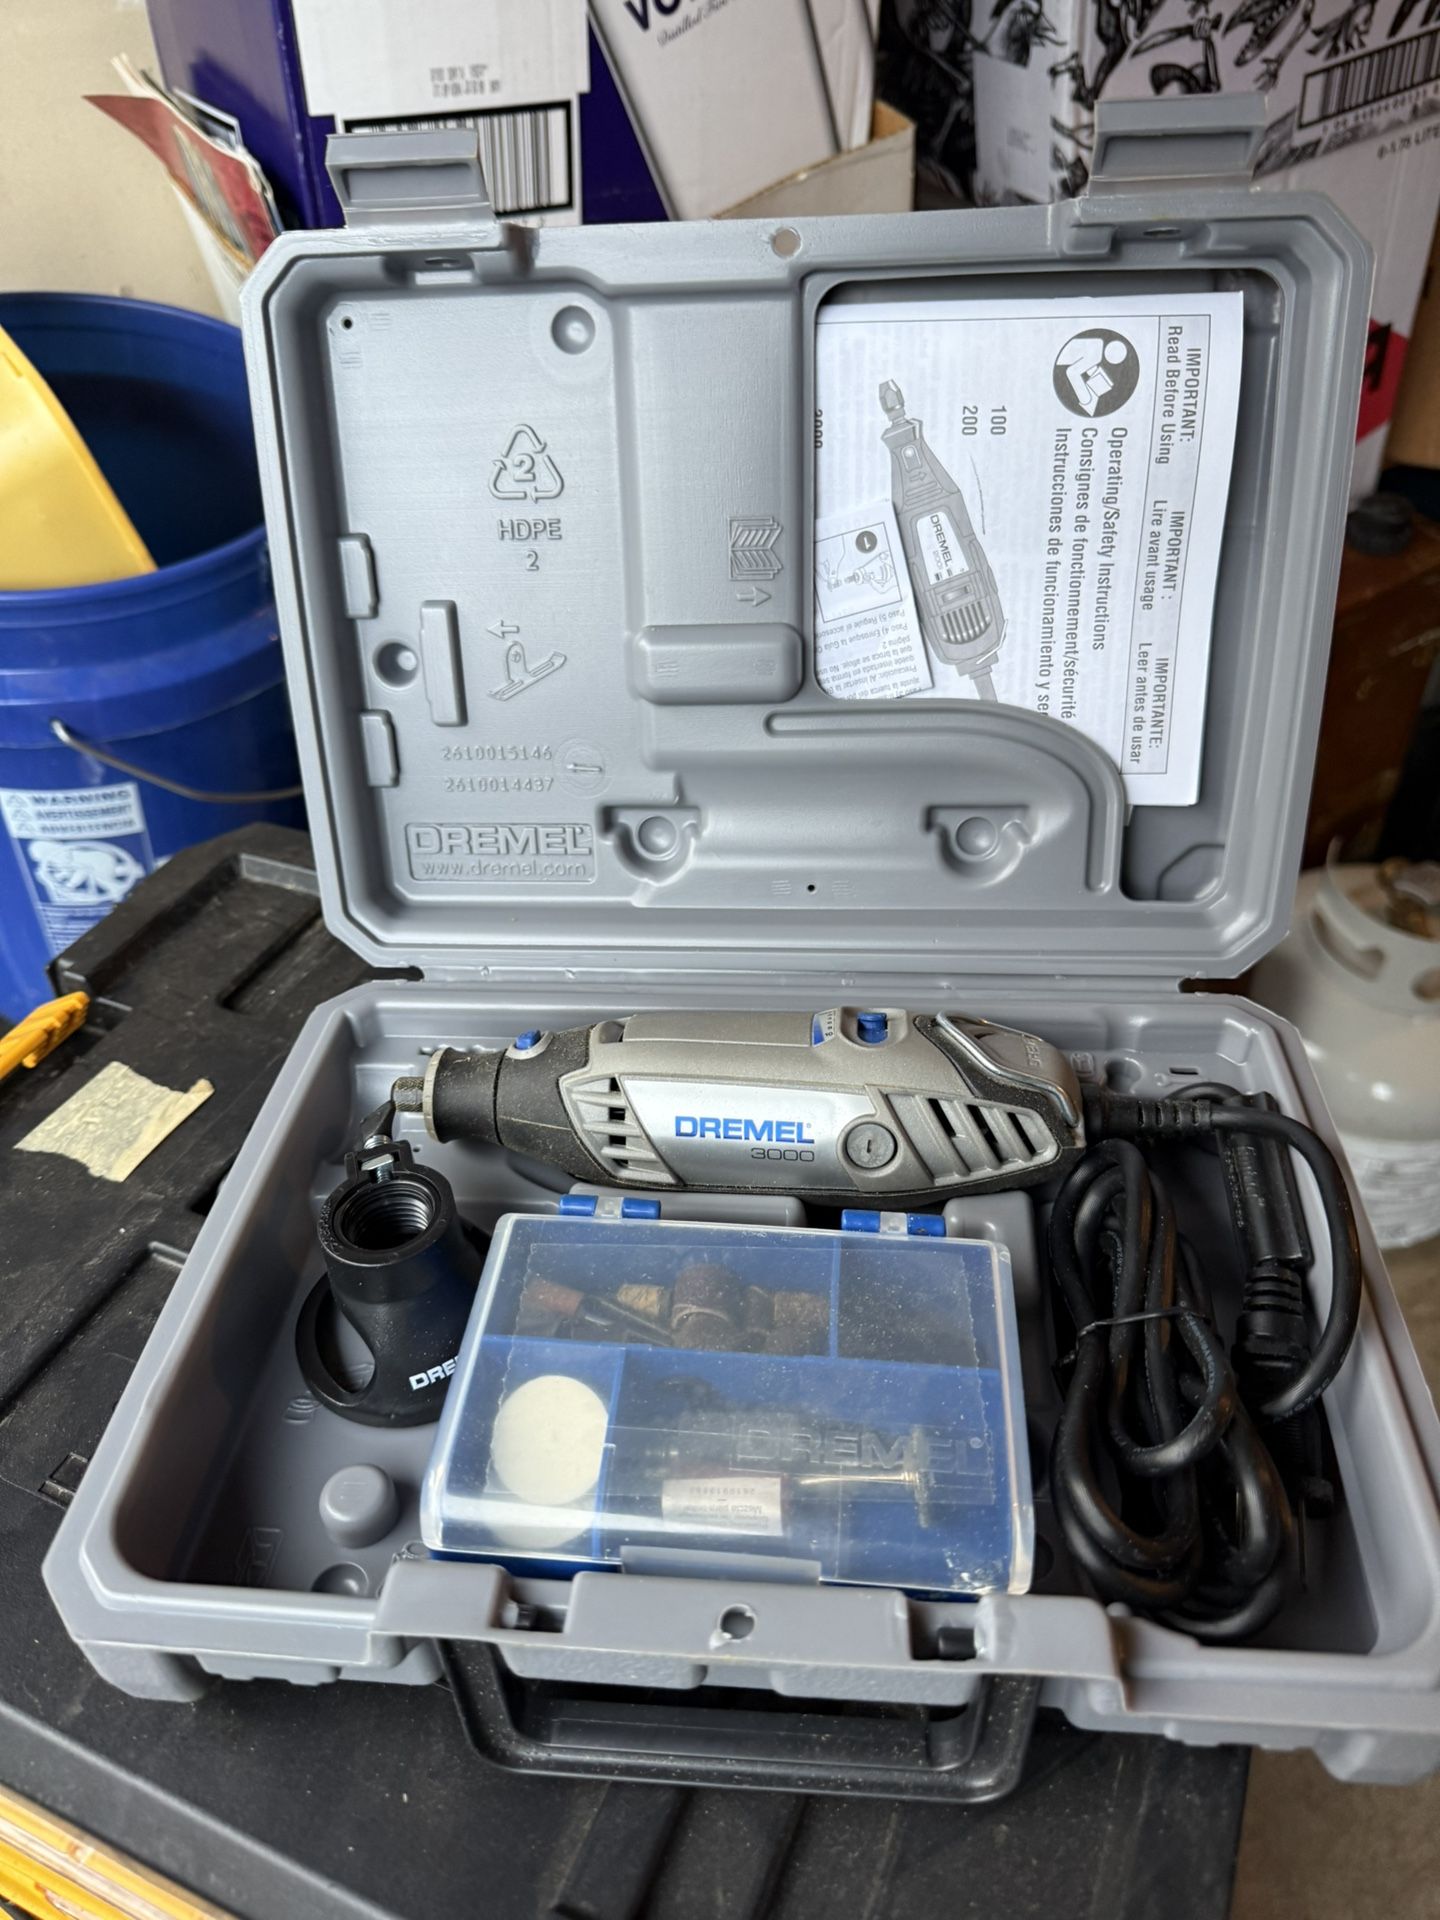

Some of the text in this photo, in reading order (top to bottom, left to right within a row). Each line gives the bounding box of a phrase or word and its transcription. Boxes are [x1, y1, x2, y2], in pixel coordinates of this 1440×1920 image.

[1155, 326, 1183, 465] Read Before Using
[1179, 348, 1202, 443] IMPORTANT:
[961, 405, 978, 436] 200
[990, 405, 1007, 436] 100
[513, 453, 537, 483] 2
[1049, 428, 1072, 533] Instrucciones
[498, 518, 563, 541] HDPE
[930, 514, 952, 568] DREMEL
[1092, 427, 1128, 651] Operating/Safety Instructions
[526, 550, 540, 571] 2
[1047, 537, 1063, 556] de
[1139, 500, 1168, 611] Lire avant usage
[1061, 427, 1098, 719] Consignes de fonctionnement/sécurité
[1038, 561, 1061, 678] funcionamiento
[1035, 681, 1050, 690] y
[1130, 642, 1152, 764] Leer antes de usar
[1149, 657, 1170, 749] IMPORTANTE:
[442, 745, 553, 761] 2610015146
[444, 777, 554, 792] 2610014437
[411, 825, 592, 856] DREMEL
[422, 859, 586, 878] www.dremel.com
[675, 1115, 815, 1145] DREMEL
[751, 1147, 815, 1162] 3000
[409, 1355, 459, 1391] DRE
